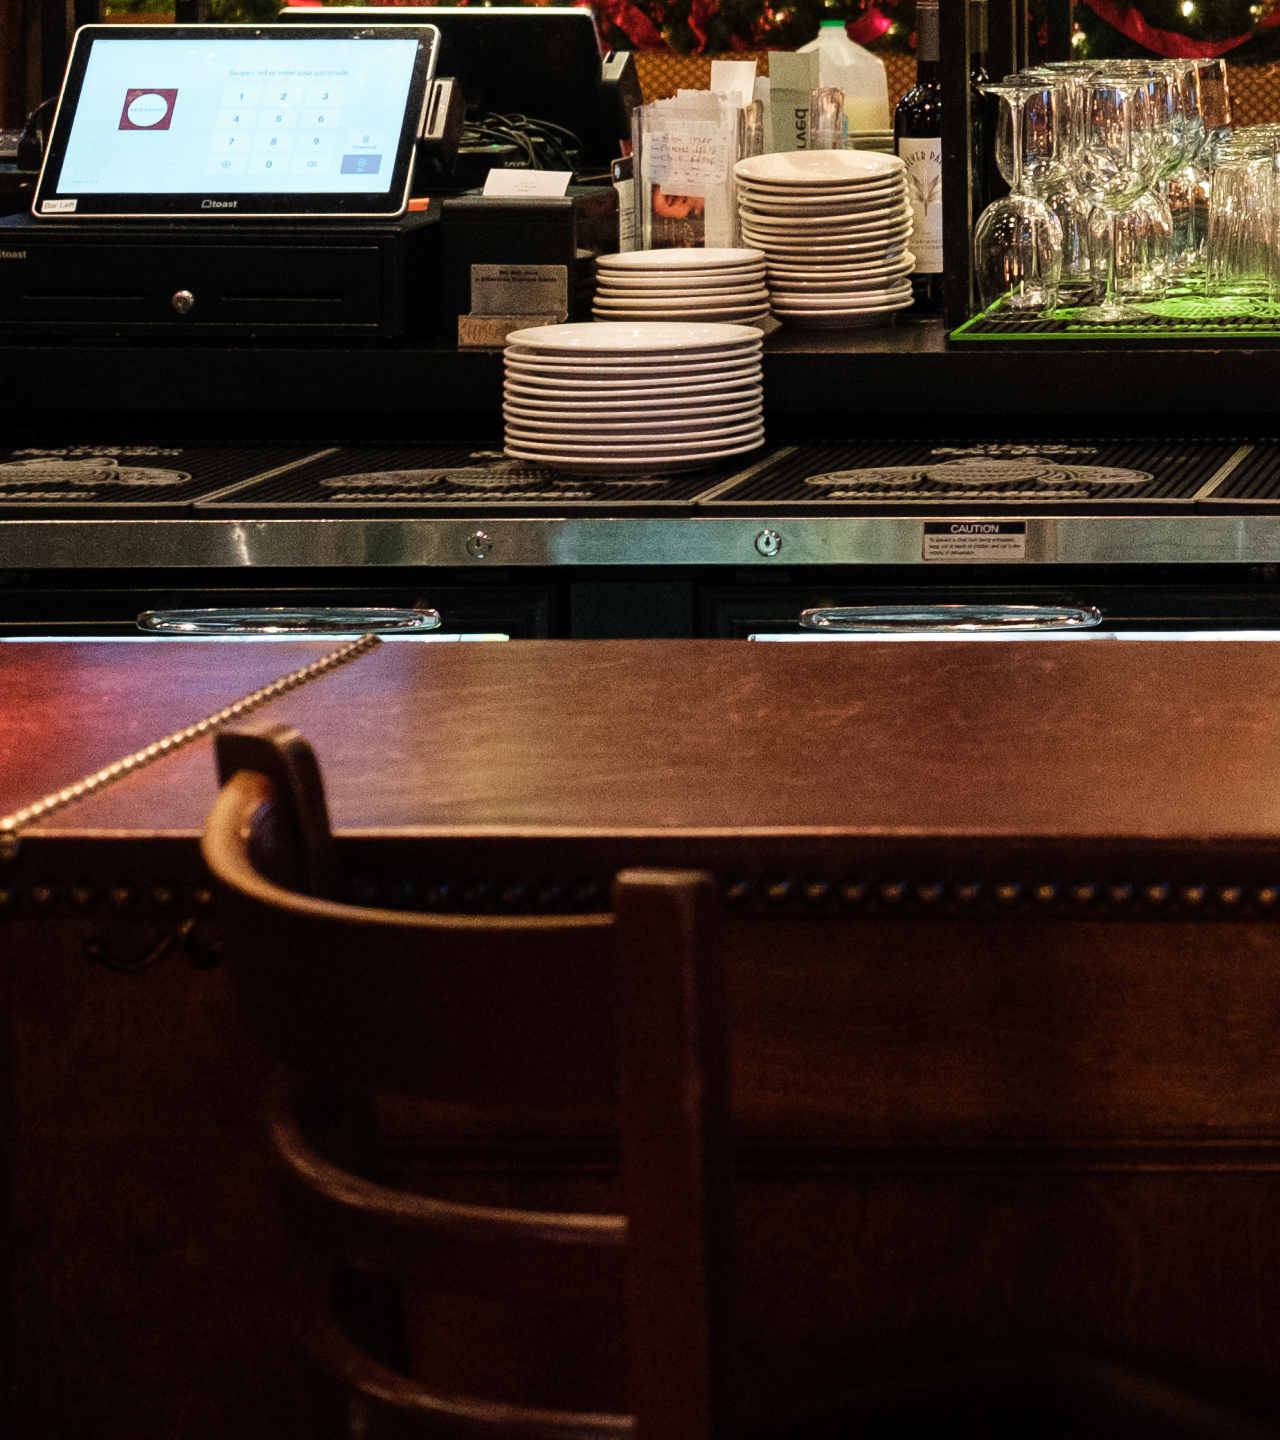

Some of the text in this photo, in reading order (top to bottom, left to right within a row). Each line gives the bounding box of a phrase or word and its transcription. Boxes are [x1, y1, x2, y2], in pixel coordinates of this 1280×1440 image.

[211, 200, 239, 209] toast
[2, 249, 28, 259] toast
[950, 523, 999, 534] CAUTION
